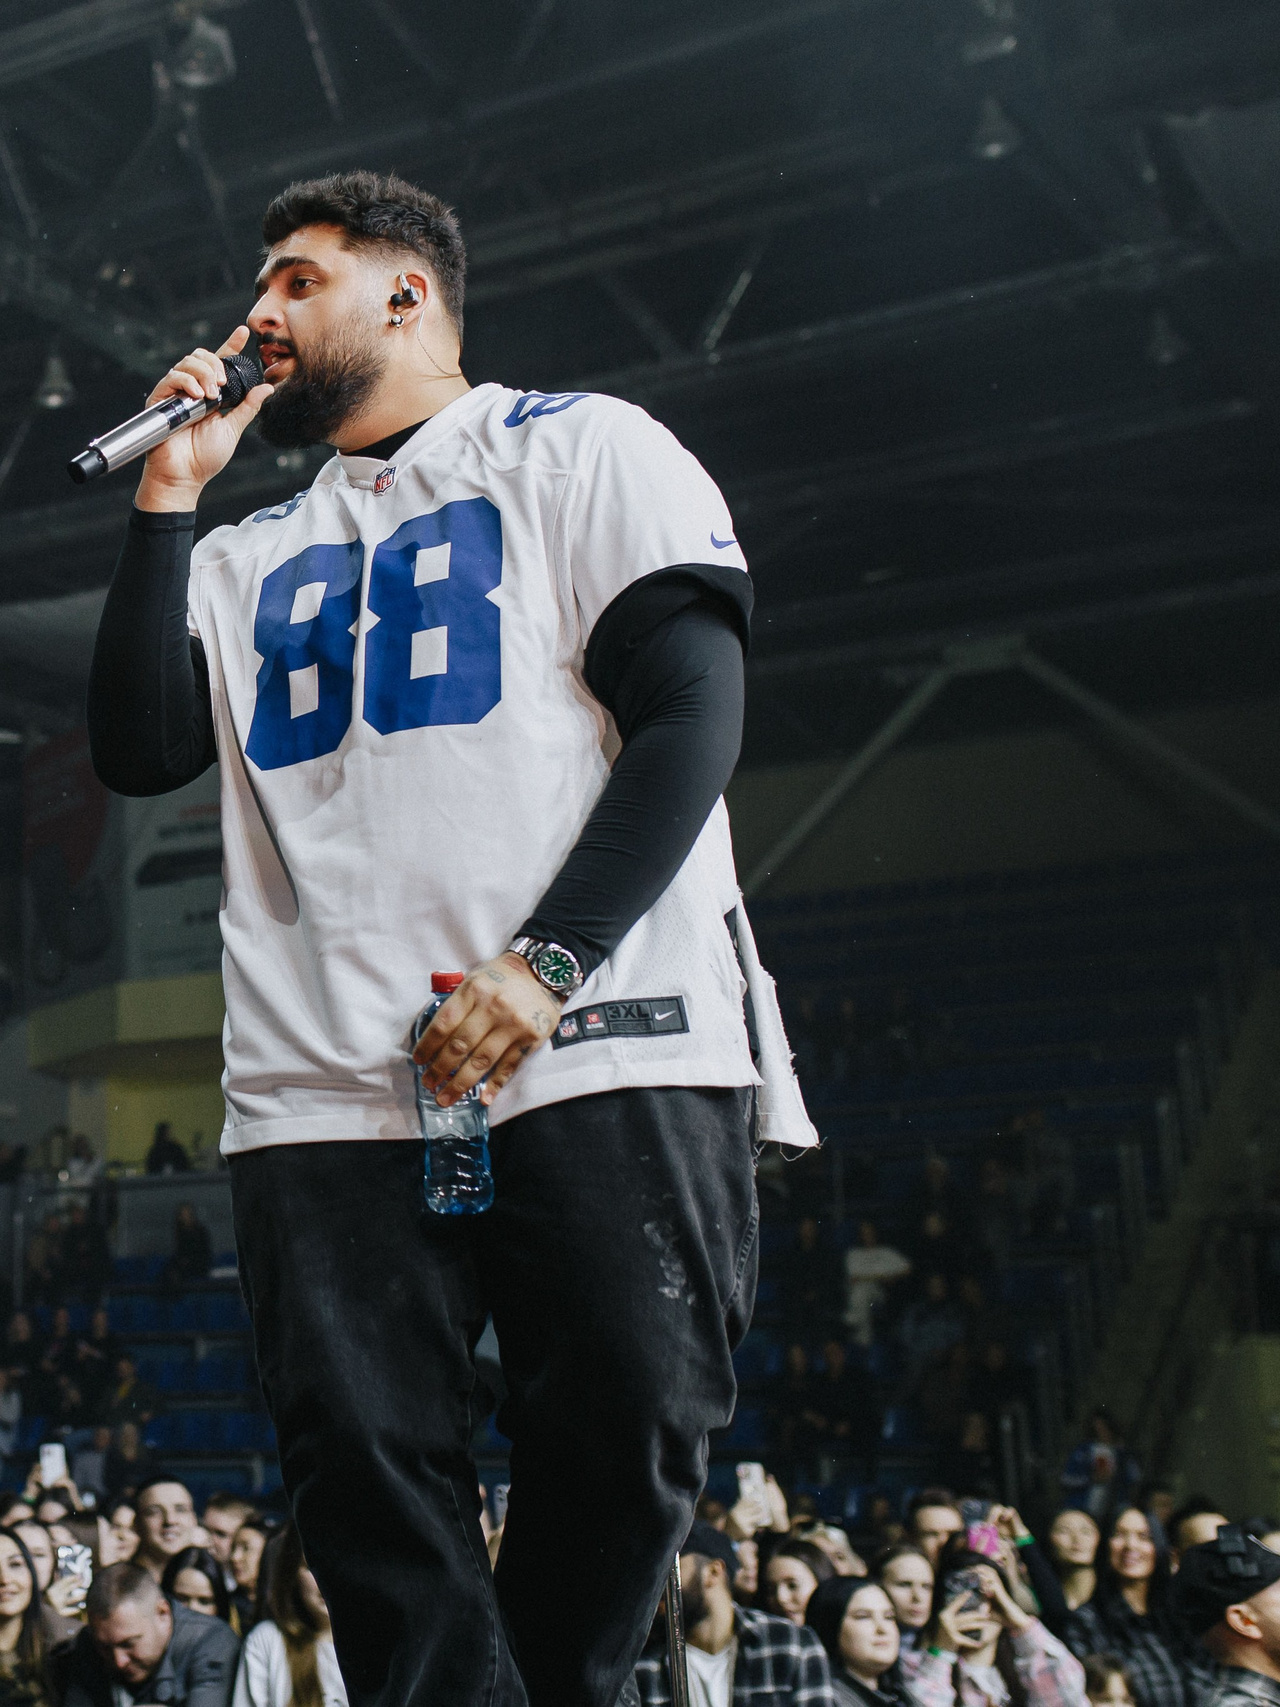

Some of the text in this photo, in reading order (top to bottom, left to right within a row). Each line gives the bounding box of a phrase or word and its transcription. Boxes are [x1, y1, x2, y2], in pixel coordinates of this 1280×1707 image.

[375, 474, 392, 491] NFL
[245, 496, 503, 771] 88
[608, 1003, 647, 1019] 3XL
